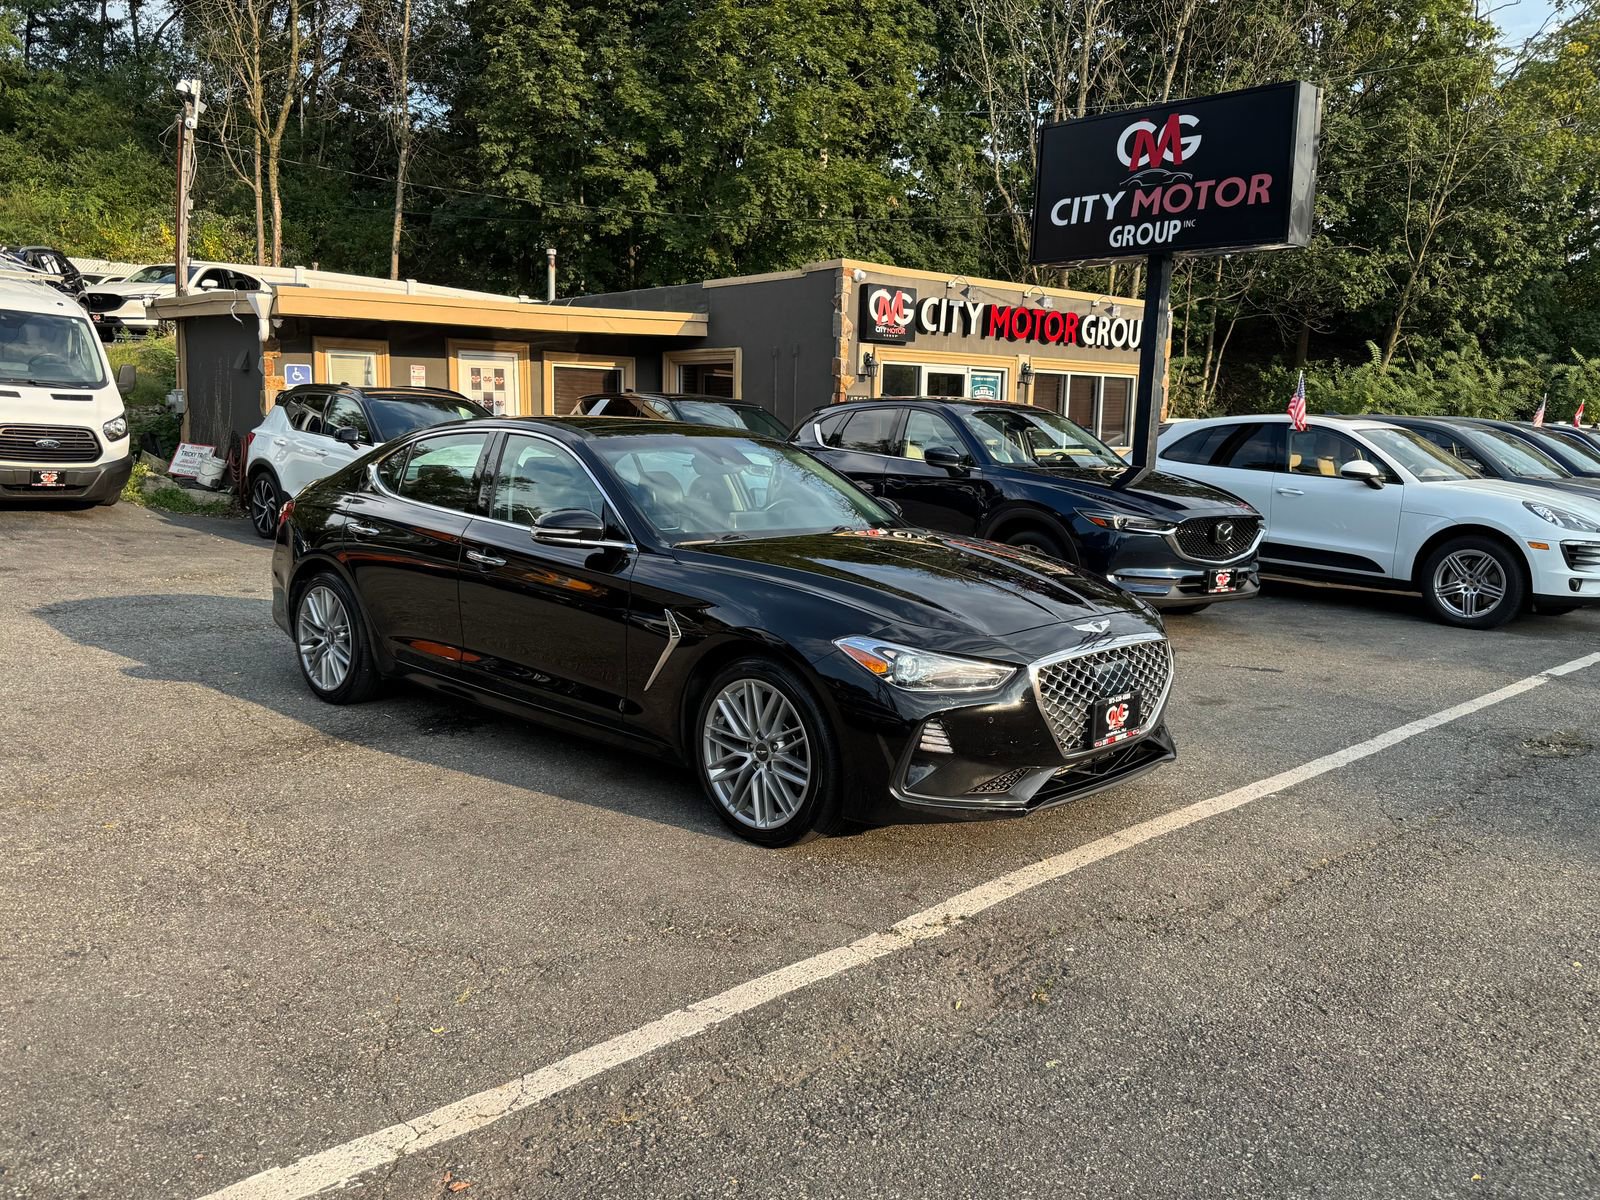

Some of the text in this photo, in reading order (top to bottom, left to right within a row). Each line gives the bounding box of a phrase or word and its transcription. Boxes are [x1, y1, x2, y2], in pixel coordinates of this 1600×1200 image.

[1050, 173, 1273, 226] CITY MOTOR
[1108, 219, 1196, 248] GROUP INC
[886, 327, 906, 335] MOTOR
[921, 297, 1142, 349] CITY MOTOR GROU
